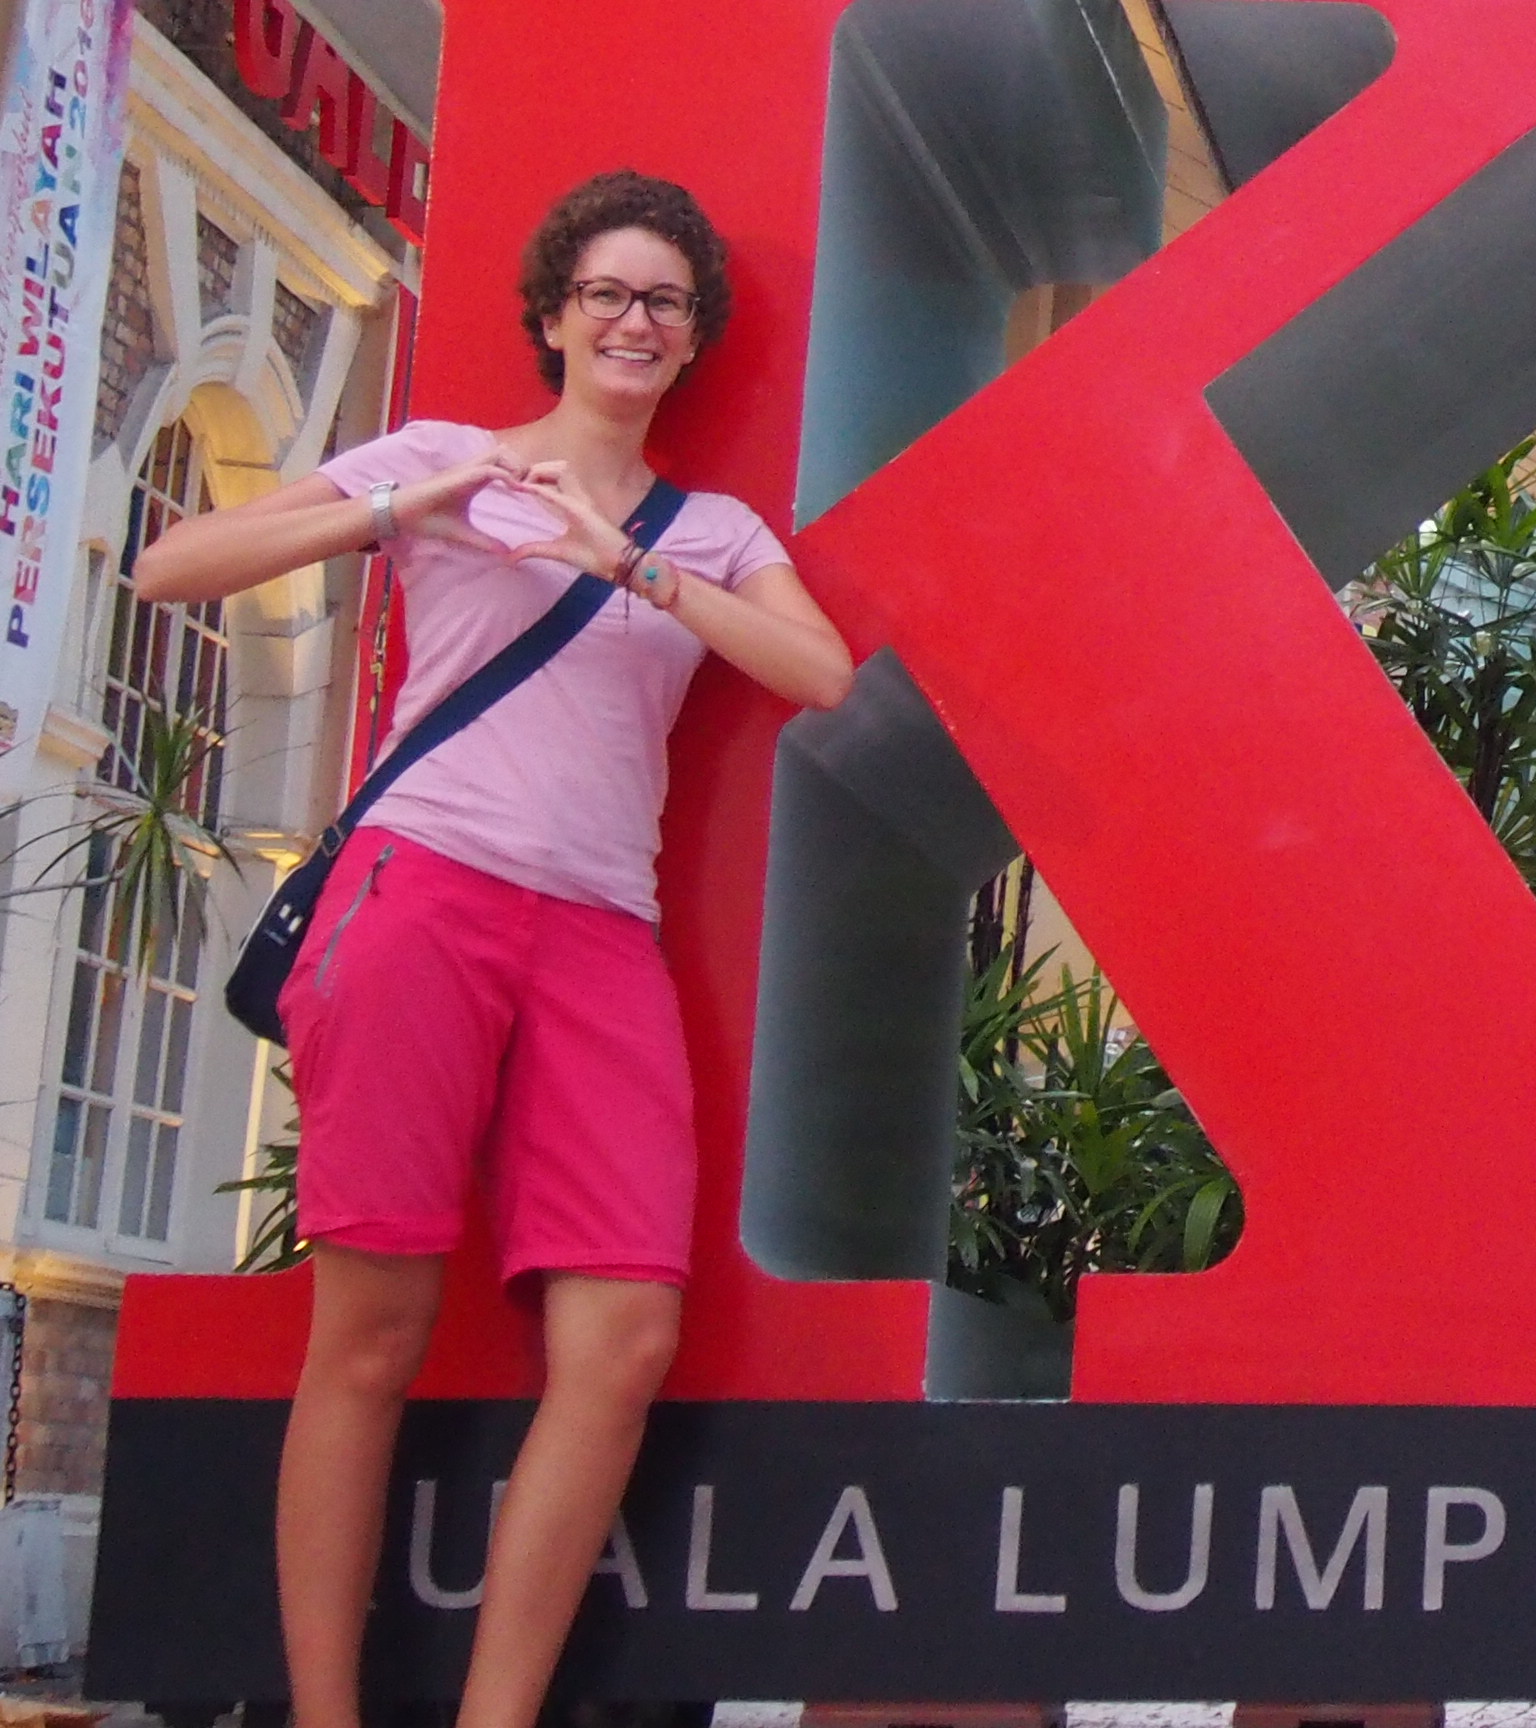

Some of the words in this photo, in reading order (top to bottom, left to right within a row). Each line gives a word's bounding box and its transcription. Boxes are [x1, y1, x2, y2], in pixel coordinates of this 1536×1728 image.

[0, 370, 36, 537] HARI
[18, 67, 67, 356] WILAYAH
[6, 143, 82, 649] PERSEKUTUAN
